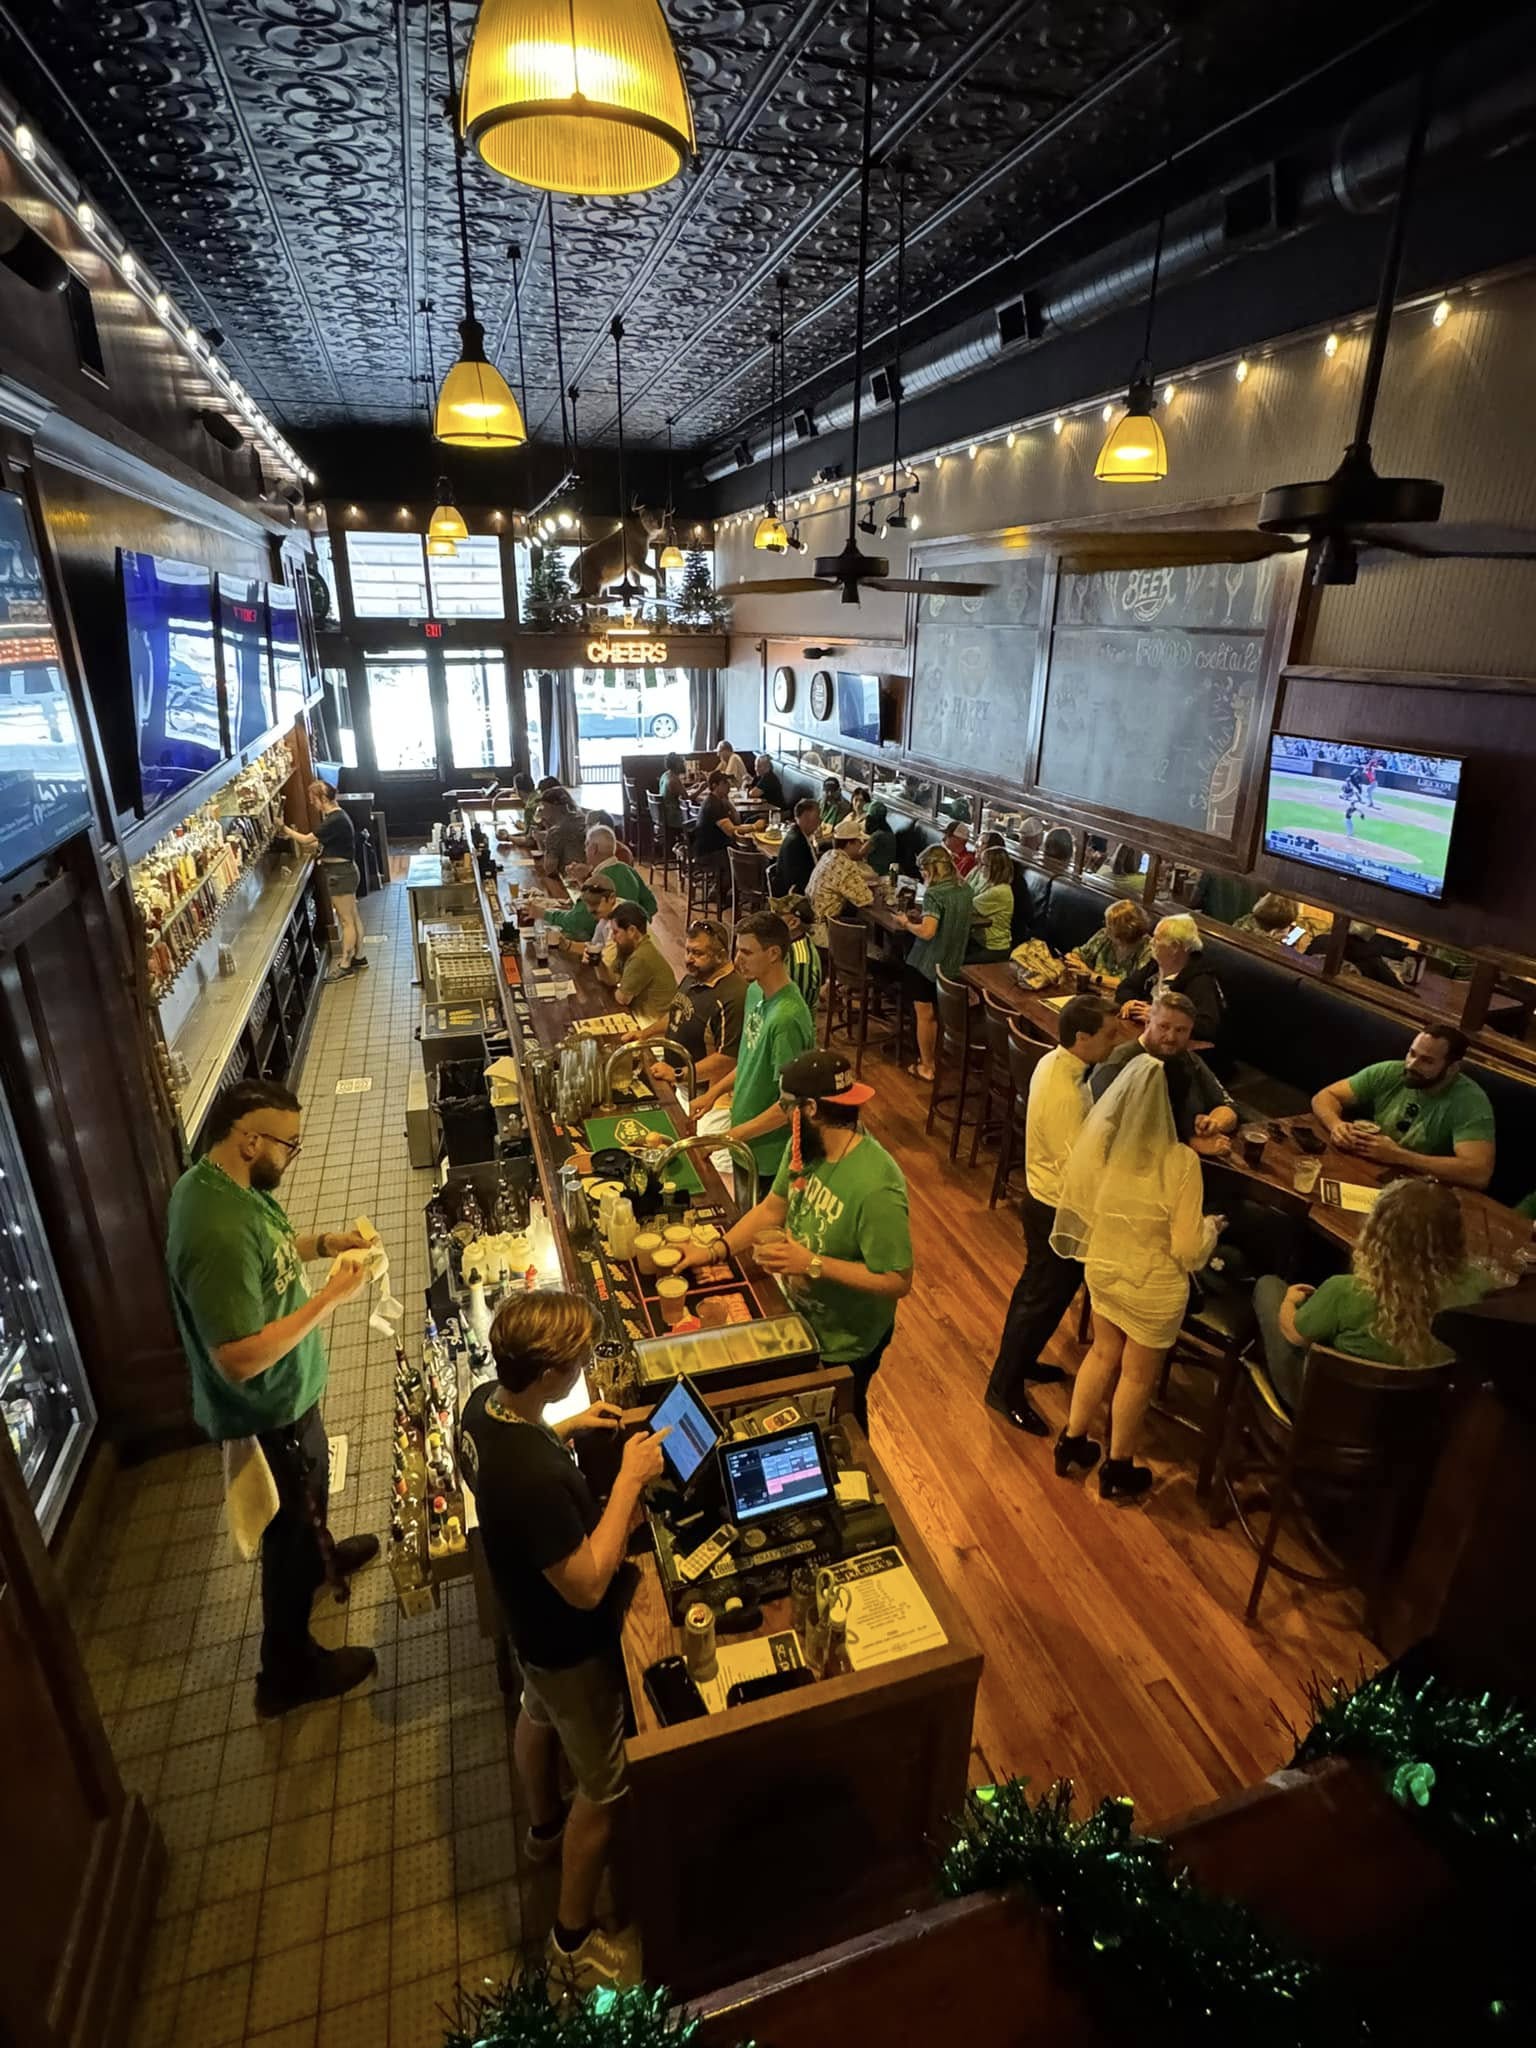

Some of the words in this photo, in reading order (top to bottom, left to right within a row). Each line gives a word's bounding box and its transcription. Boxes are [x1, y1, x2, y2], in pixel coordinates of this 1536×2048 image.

[1122, 567, 1176, 612] BEER
[425, 623, 442, 638] EXIT
[587, 642, 667, 663] CHEERS
